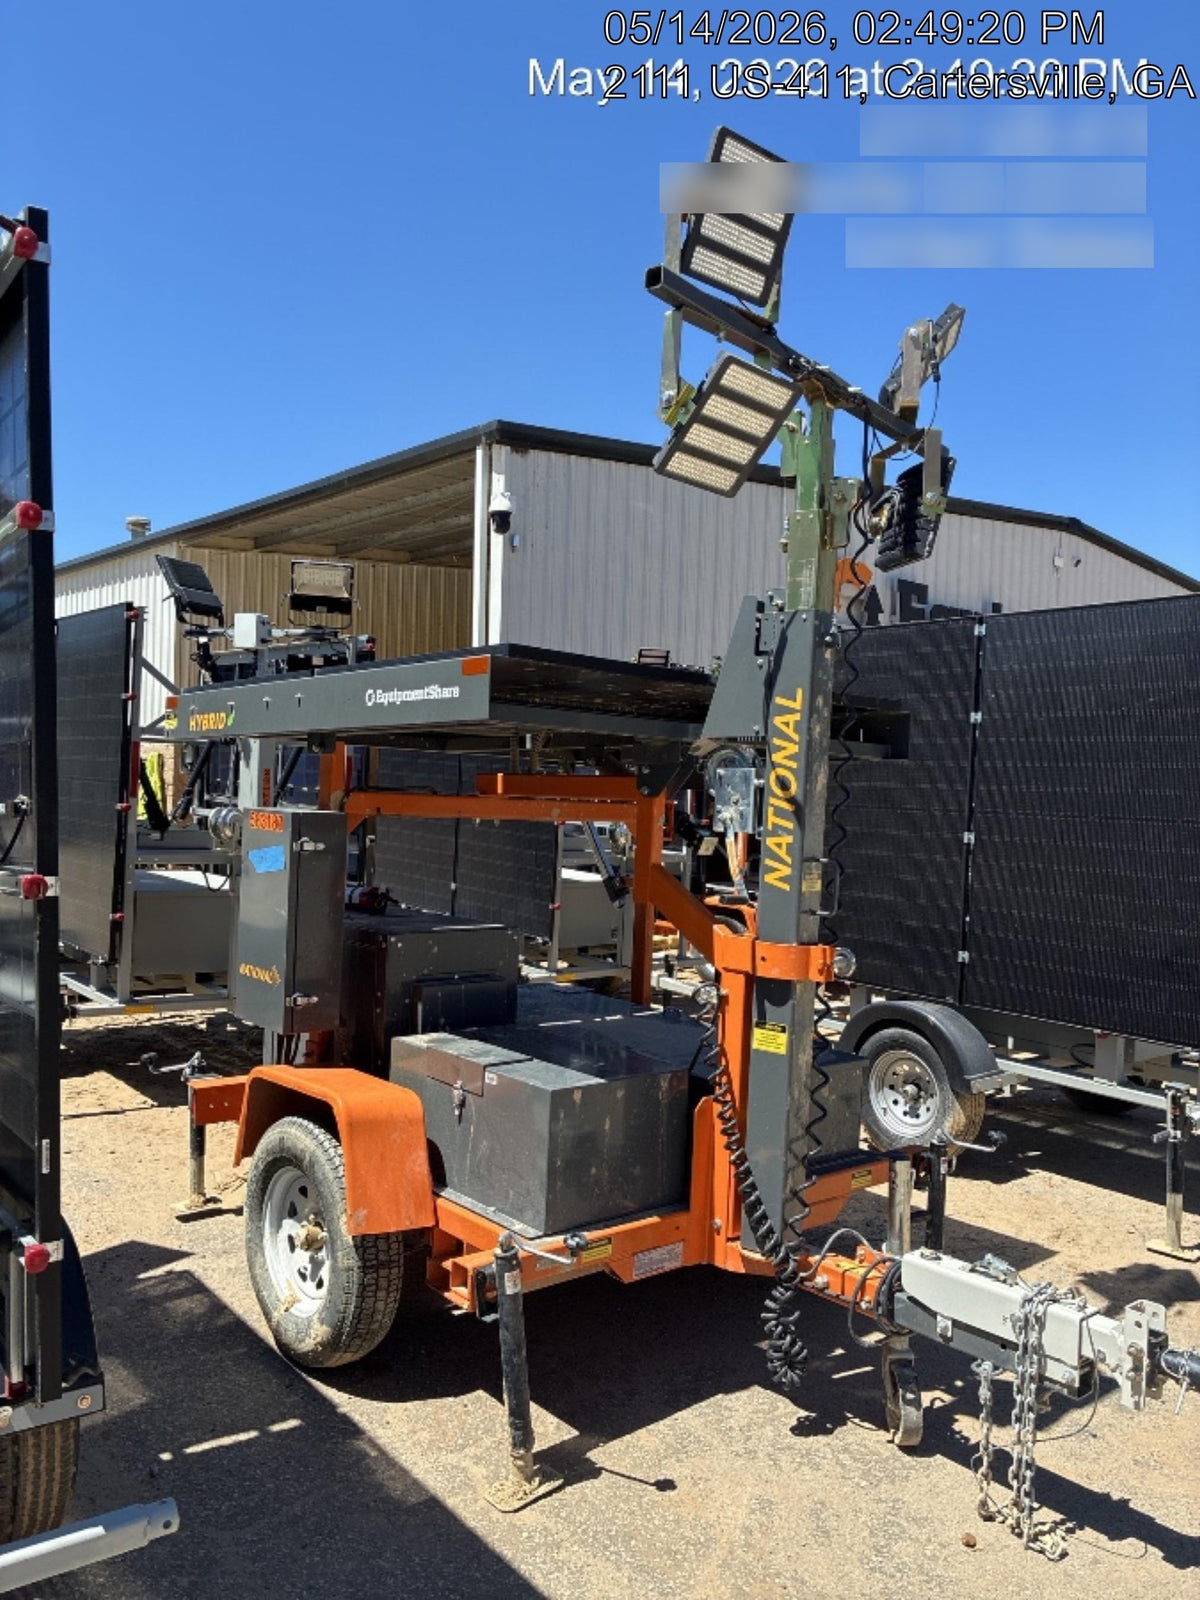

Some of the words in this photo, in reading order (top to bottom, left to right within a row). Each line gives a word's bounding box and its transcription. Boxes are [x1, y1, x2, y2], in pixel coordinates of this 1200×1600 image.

[376, 684, 460, 707] EquipmentShare
[189, 711, 227, 732] HYBRID
[763, 687, 804, 892] NATIONAL
